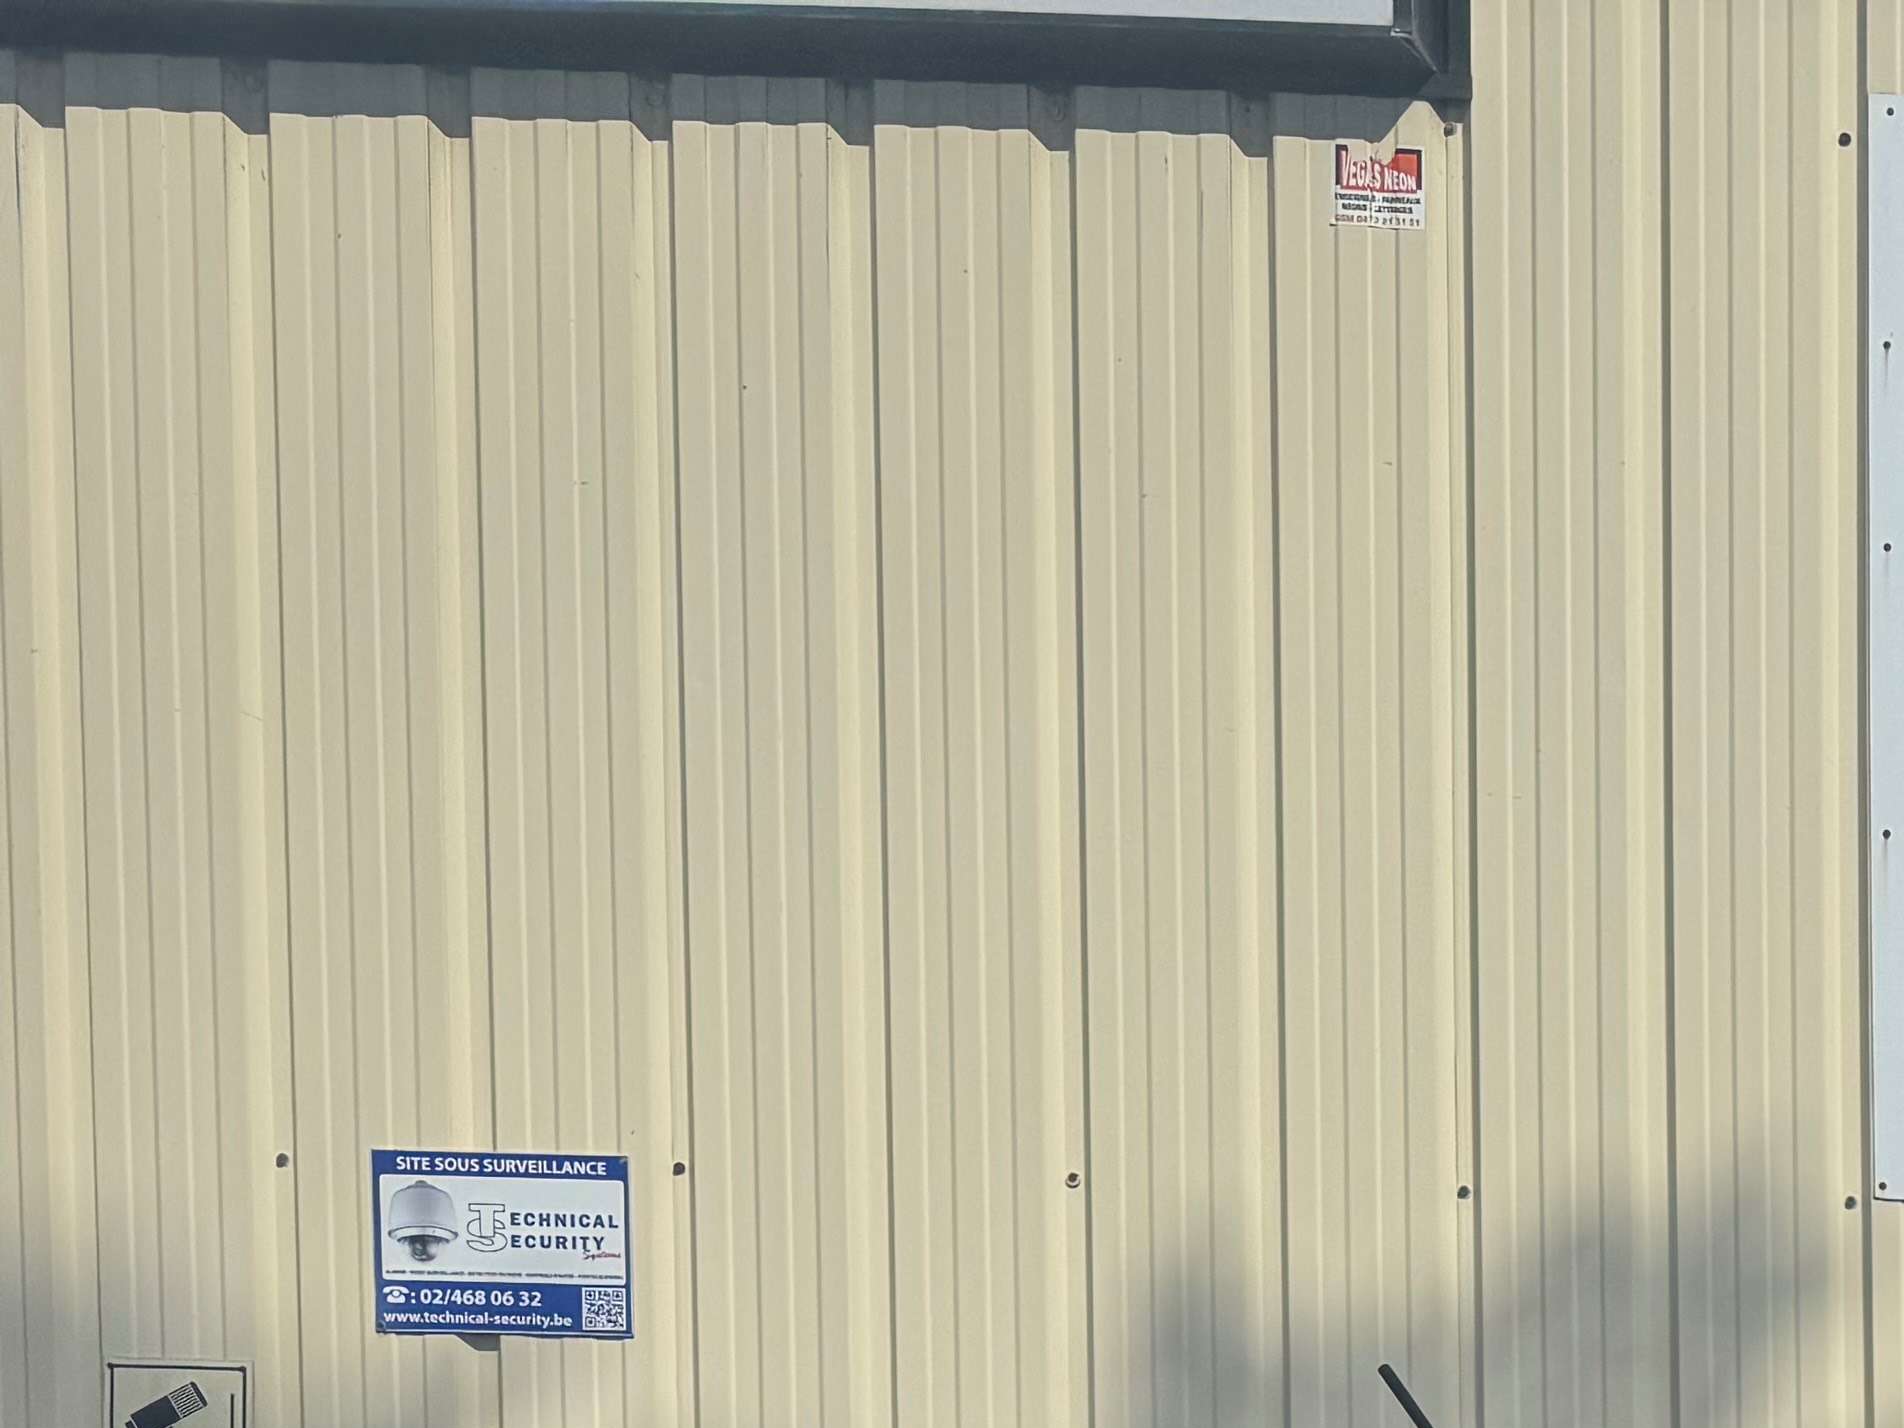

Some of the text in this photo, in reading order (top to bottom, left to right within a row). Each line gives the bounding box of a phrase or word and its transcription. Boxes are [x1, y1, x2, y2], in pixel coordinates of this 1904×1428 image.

[1384, 166, 1416, 190] NEON
[396, 1156, 607, 1176] SITE SOUS SURVEILLANCE
[420, 1288, 486, 1306] 02/468
[491, 1290, 514, 1306] 06
[519, 1291, 542, 1307] 32
[384, 1311, 573, 1329] www.technical-security.be
